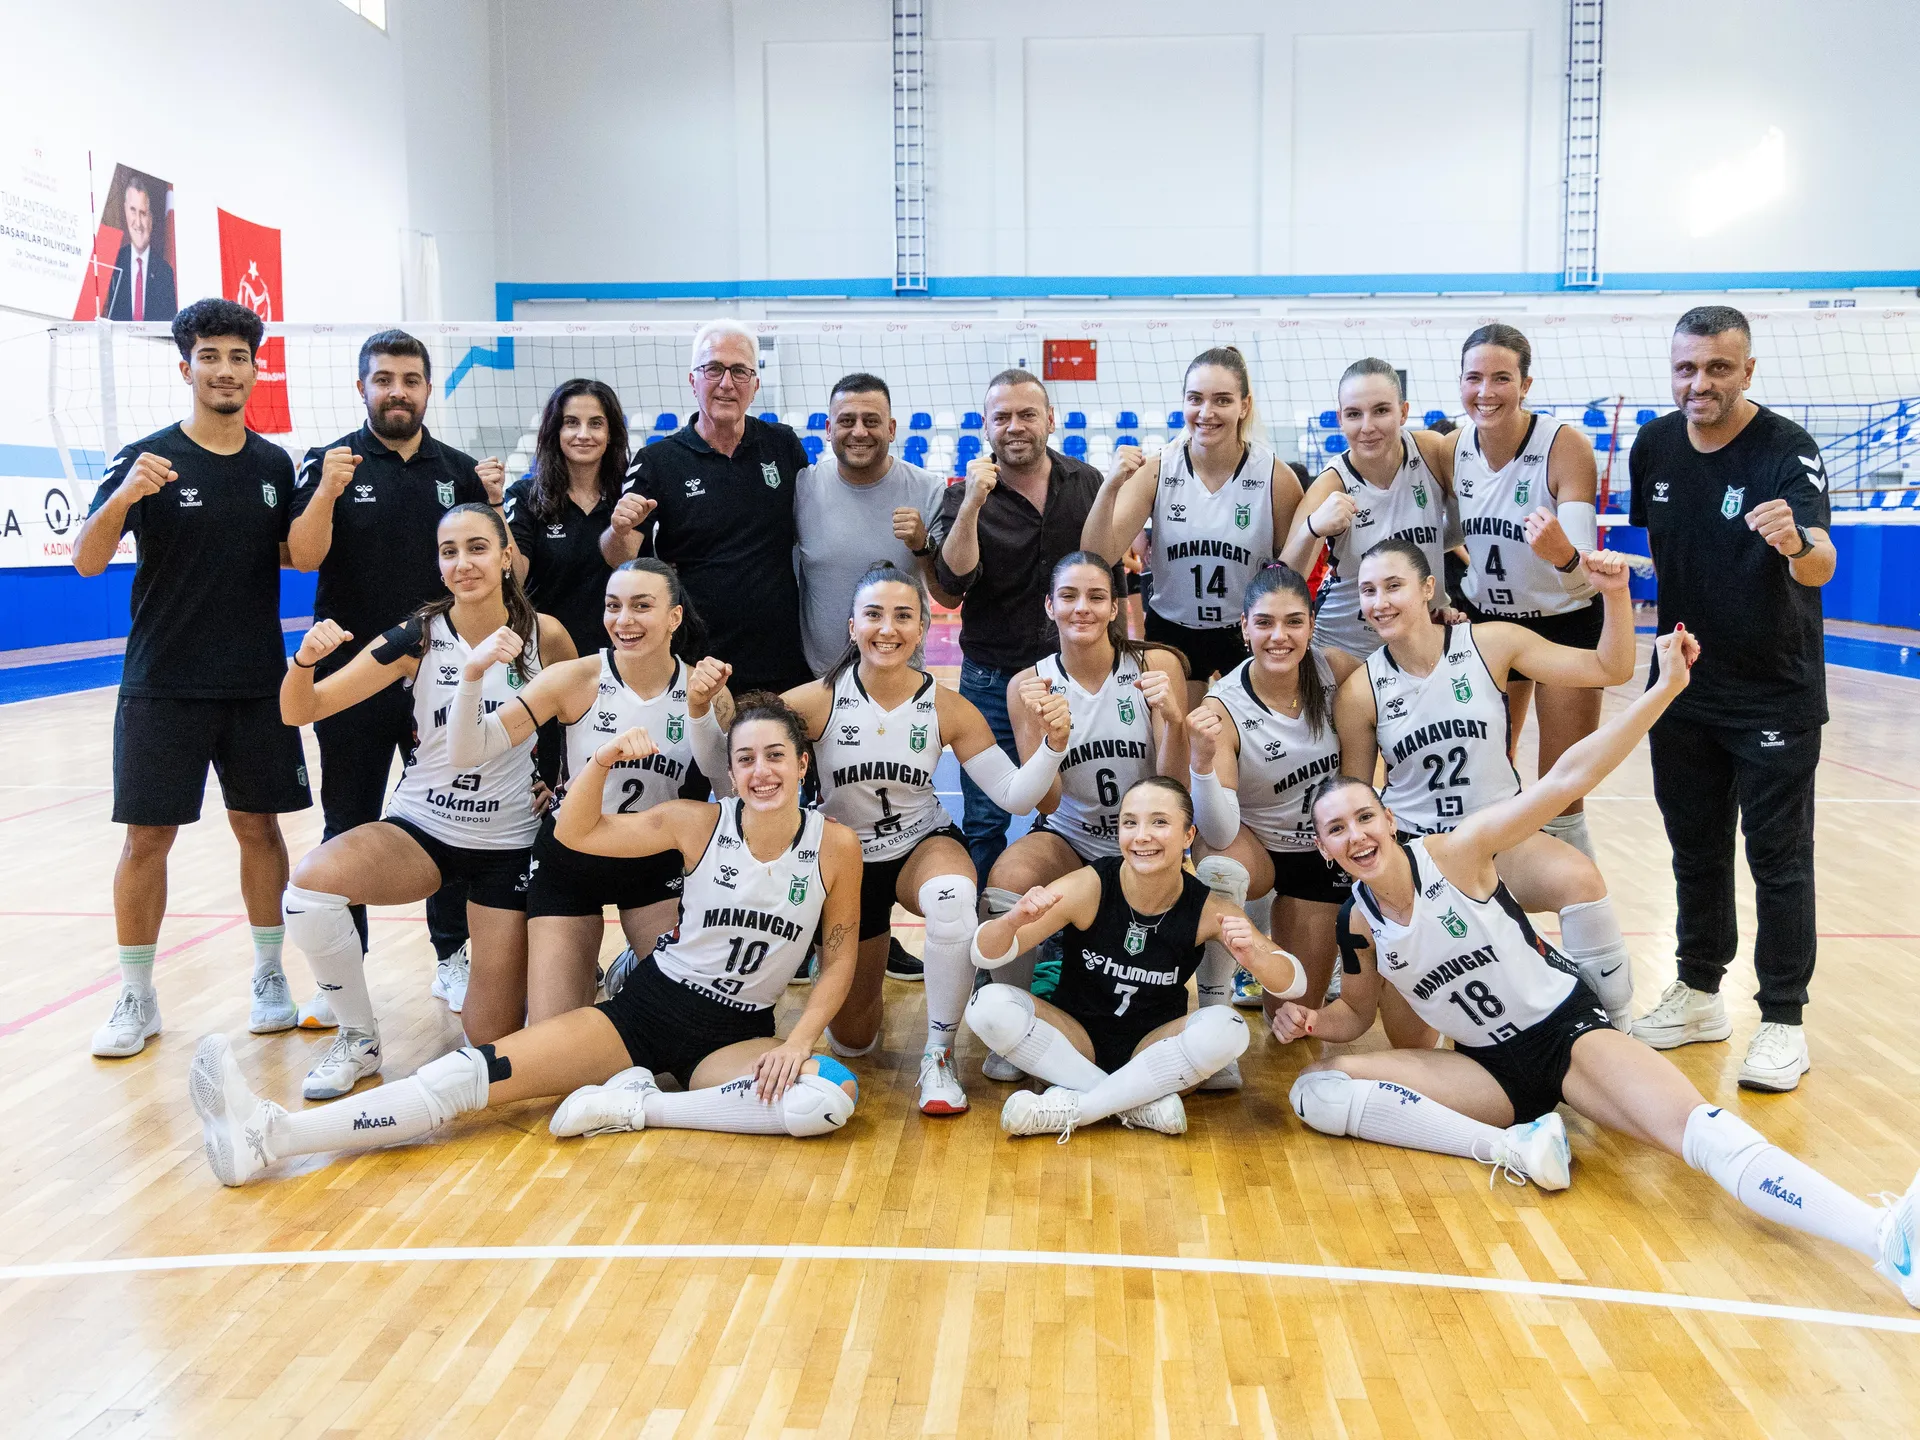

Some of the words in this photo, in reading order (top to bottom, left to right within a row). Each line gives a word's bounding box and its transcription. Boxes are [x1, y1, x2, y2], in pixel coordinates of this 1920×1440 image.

[1167, 540, 1251, 566] MANAVGAT
[1485, 544, 1508, 582] 4
[1190, 564, 1228, 599] 14
[593, 723, 617, 734] hummel
[1387, 709, 1408, 720] hummel
[837, 738, 861, 746] hummel
[1392, 718, 1488, 764] MANAVGAT
[1264, 751, 1287, 763] hummel
[1422, 746, 1471, 793] 22
[832, 761, 929, 788] MANAVGAT
[1095, 768, 1120, 808] 6
[425, 789, 500, 813] Lokman
[617, 778, 645, 814] 2
[875, 787, 892, 818] 1
[455, 814, 491, 824] DEPOSU
[863, 843, 887, 855] ECZA
[888, 827, 919, 846] DEPOSU
[713, 876, 737, 890] hummel
[702, 908, 803, 943] MANAVGAT
[725, 936, 771, 976] 10
[1103, 957, 1180, 986] hummel
[1412, 945, 1500, 1000] MANAVGAT
[1113, 982, 1139, 1017] 7
[1449, 980, 1506, 1026] 18
[1378, 1081, 1421, 1105] MIKASA
[353, 1115, 397, 1131] MIKASA
[1759, 1176, 1803, 1210] MIKASA
